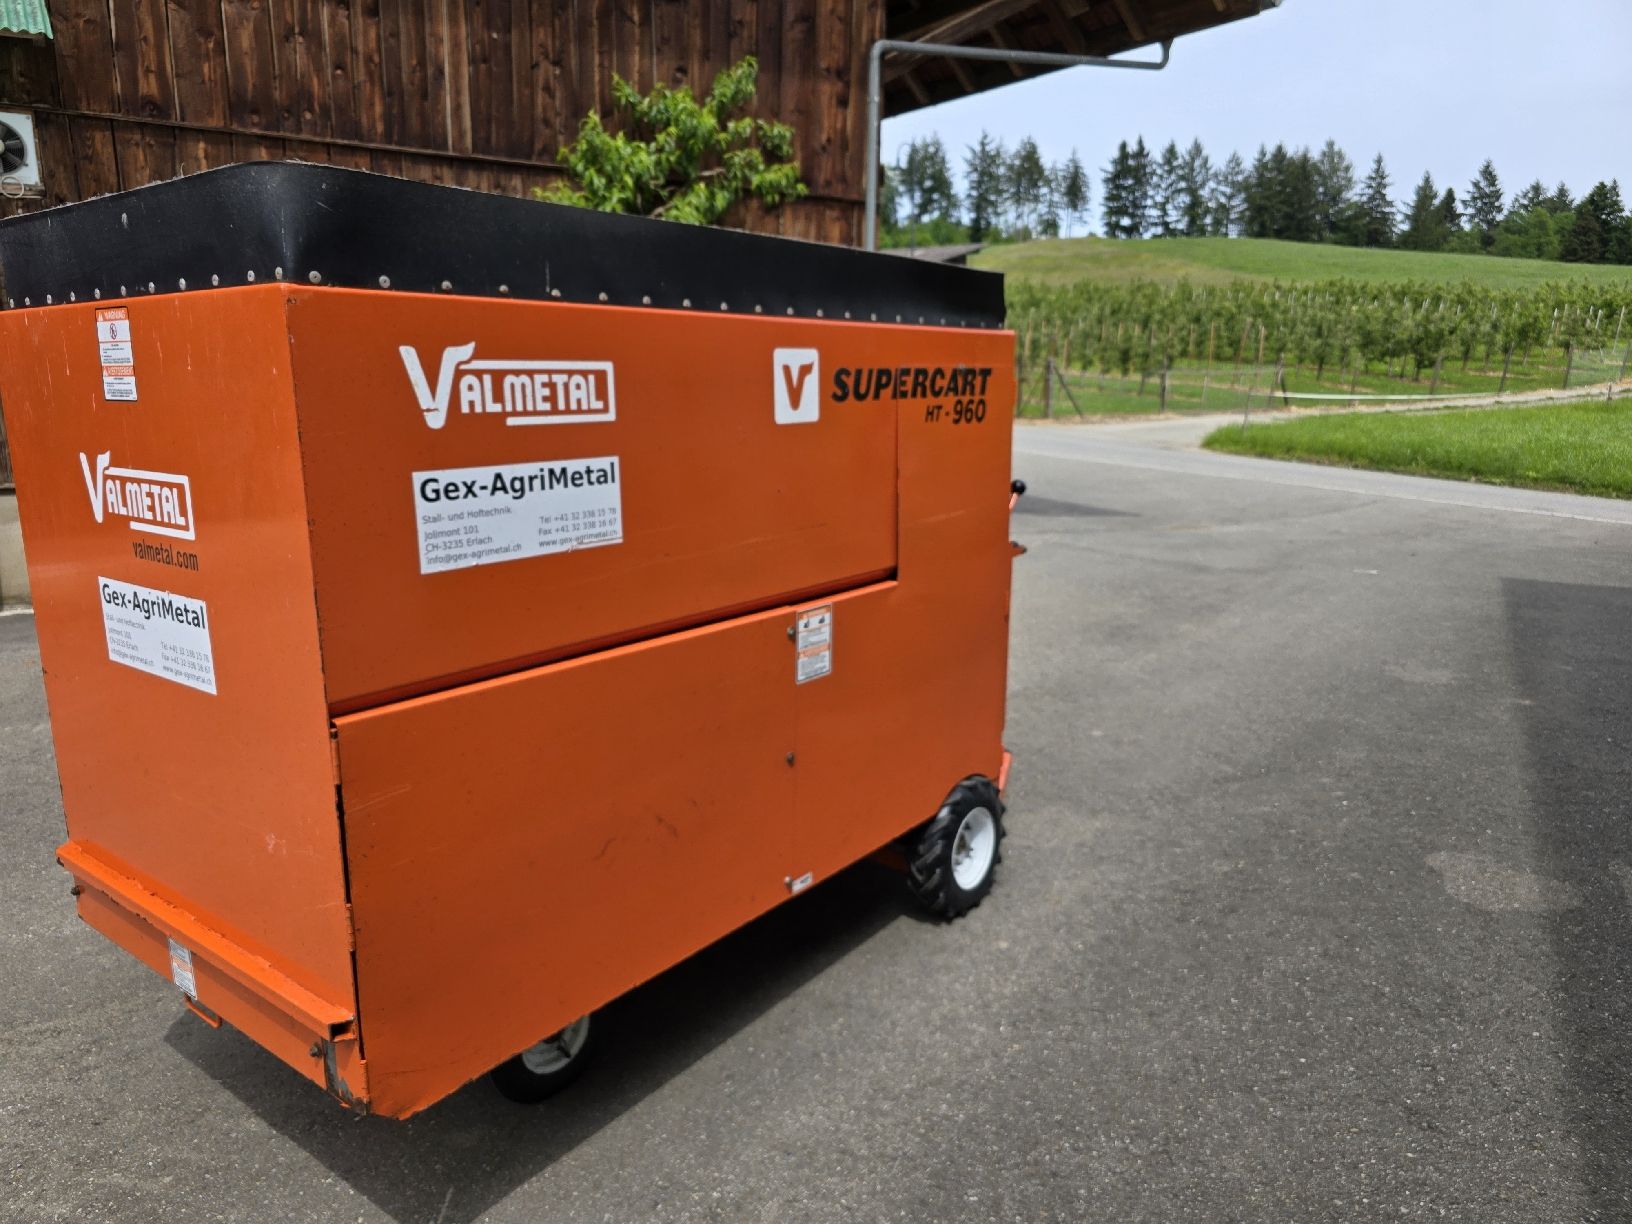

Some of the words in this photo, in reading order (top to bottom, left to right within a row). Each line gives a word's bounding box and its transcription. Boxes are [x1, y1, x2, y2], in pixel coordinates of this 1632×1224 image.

[399, 341, 604, 429] VALMETAL
[831, 367, 993, 403] SUPERCART
[952, 399, 987, 425] 960
[80, 450, 186, 526] VALMETAL
[420, 462, 616, 503] Gex-AgriMetal
[422, 513, 445, 524] Stall-
[448, 512, 464, 521] und
[467, 506, 512, 519] Hoftechnik
[424, 527, 460, 541] Jolimont
[463, 525, 479, 535] 101
[425, 539, 464, 553] CH-3235
[466, 536, 493, 547] Erlach
[538, 527, 552, 536] Fax
[132, 539, 199, 571] valmetal.com
[427, 543, 522, 564] info@gex-agrimetal.ch
[102, 583, 206, 629] Gex-AgriMetal
